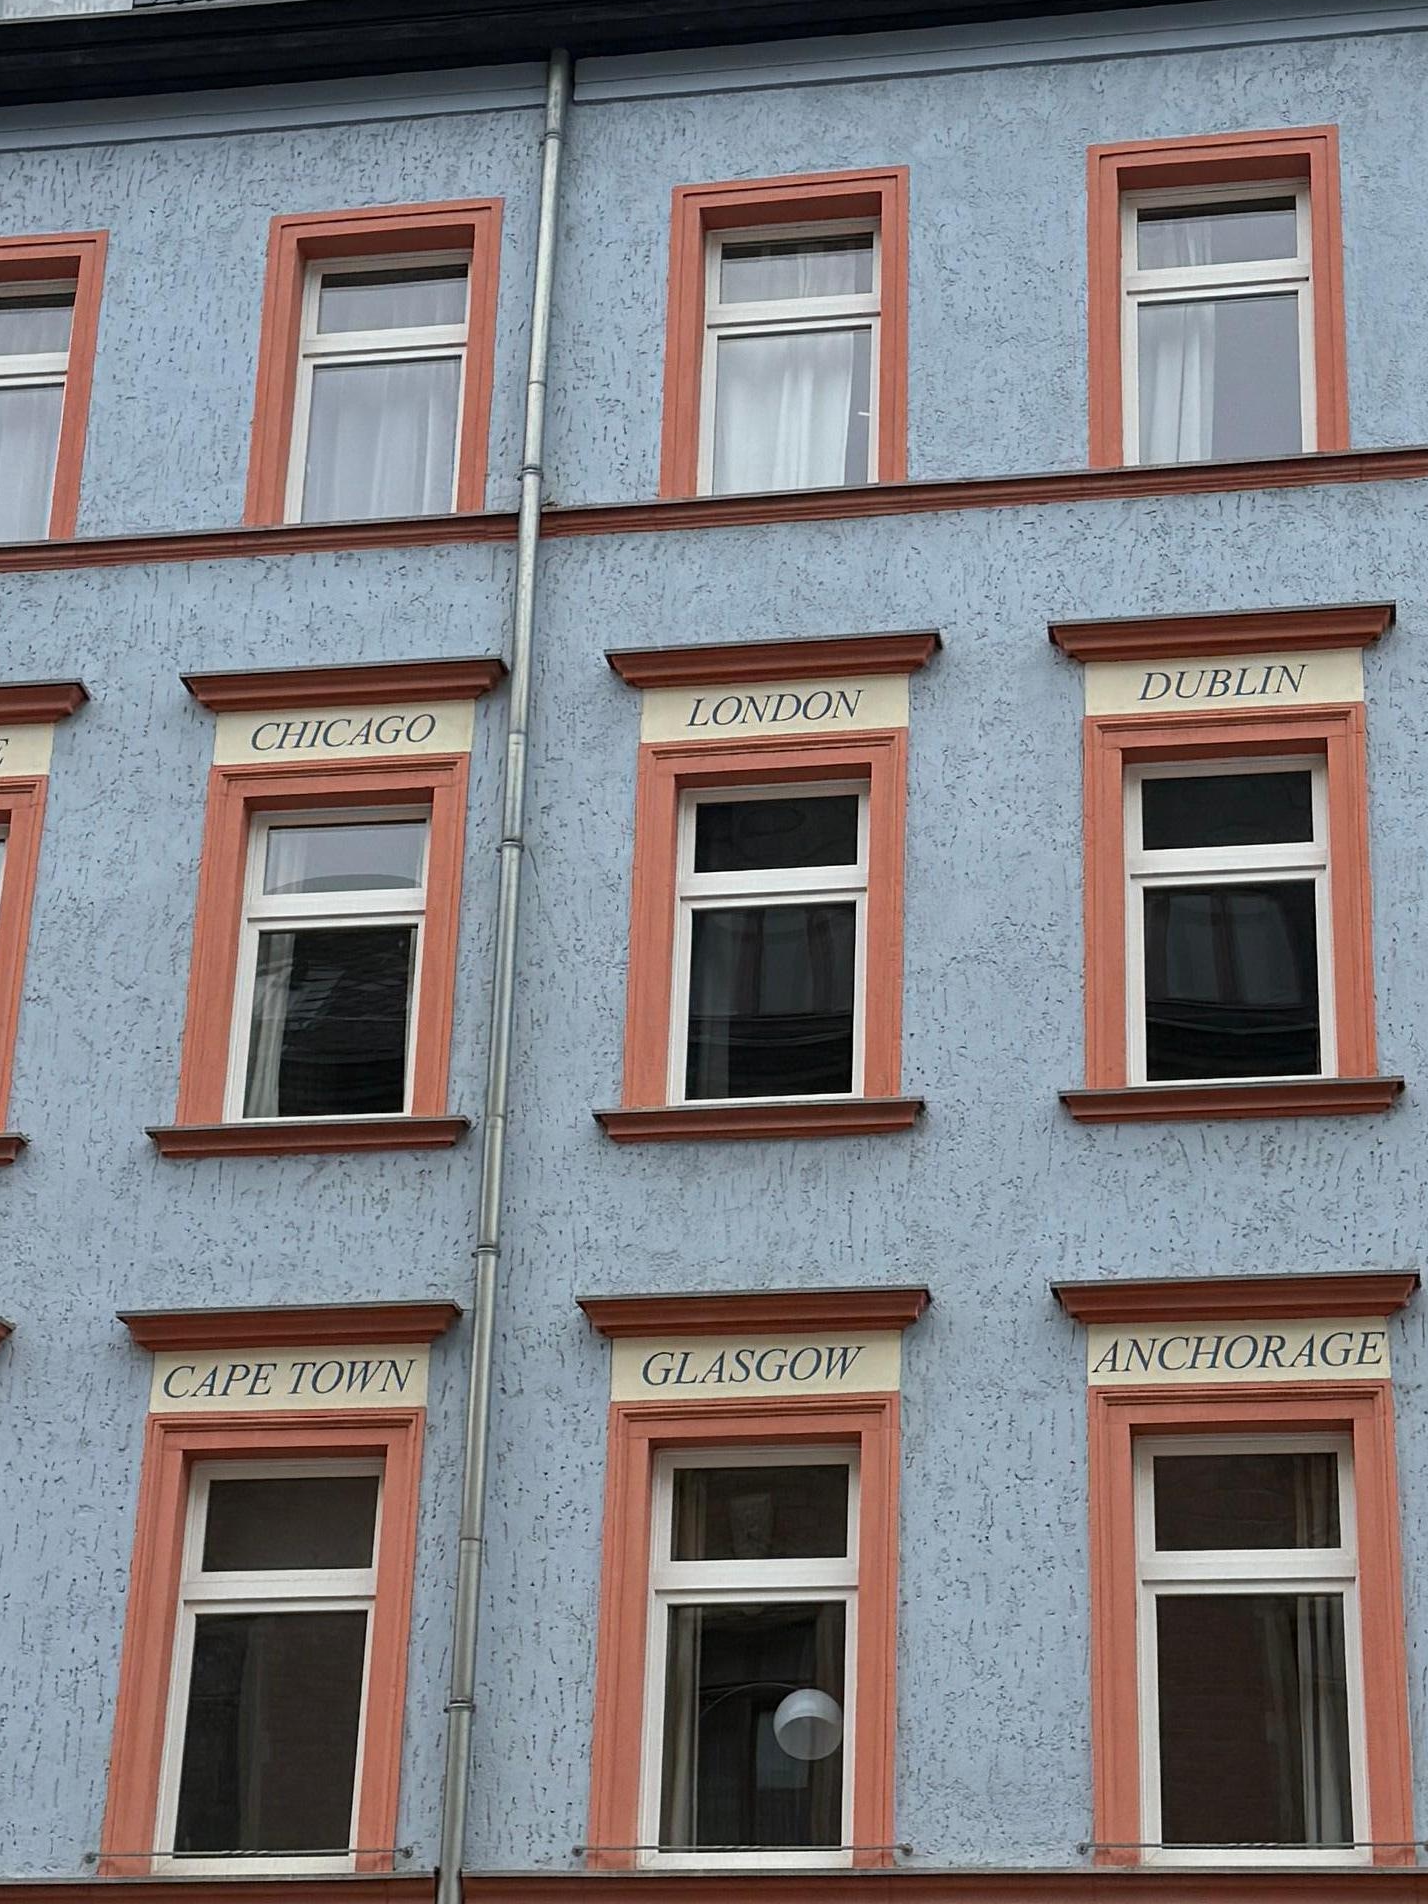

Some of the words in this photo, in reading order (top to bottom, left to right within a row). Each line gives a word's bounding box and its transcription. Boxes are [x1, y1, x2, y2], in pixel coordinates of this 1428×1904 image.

[1137, 664, 1308, 702] DUBLIN
[687, 689, 864, 727] LONDON
[250, 713, 436, 752] CHICAGO
[641, 1345, 866, 1386] GLASGOW
[1093, 1330, 1386, 1374] ANCHORAGE
[163, 1362, 278, 1399] CAPE
[288, 1358, 417, 1395] TOWN
